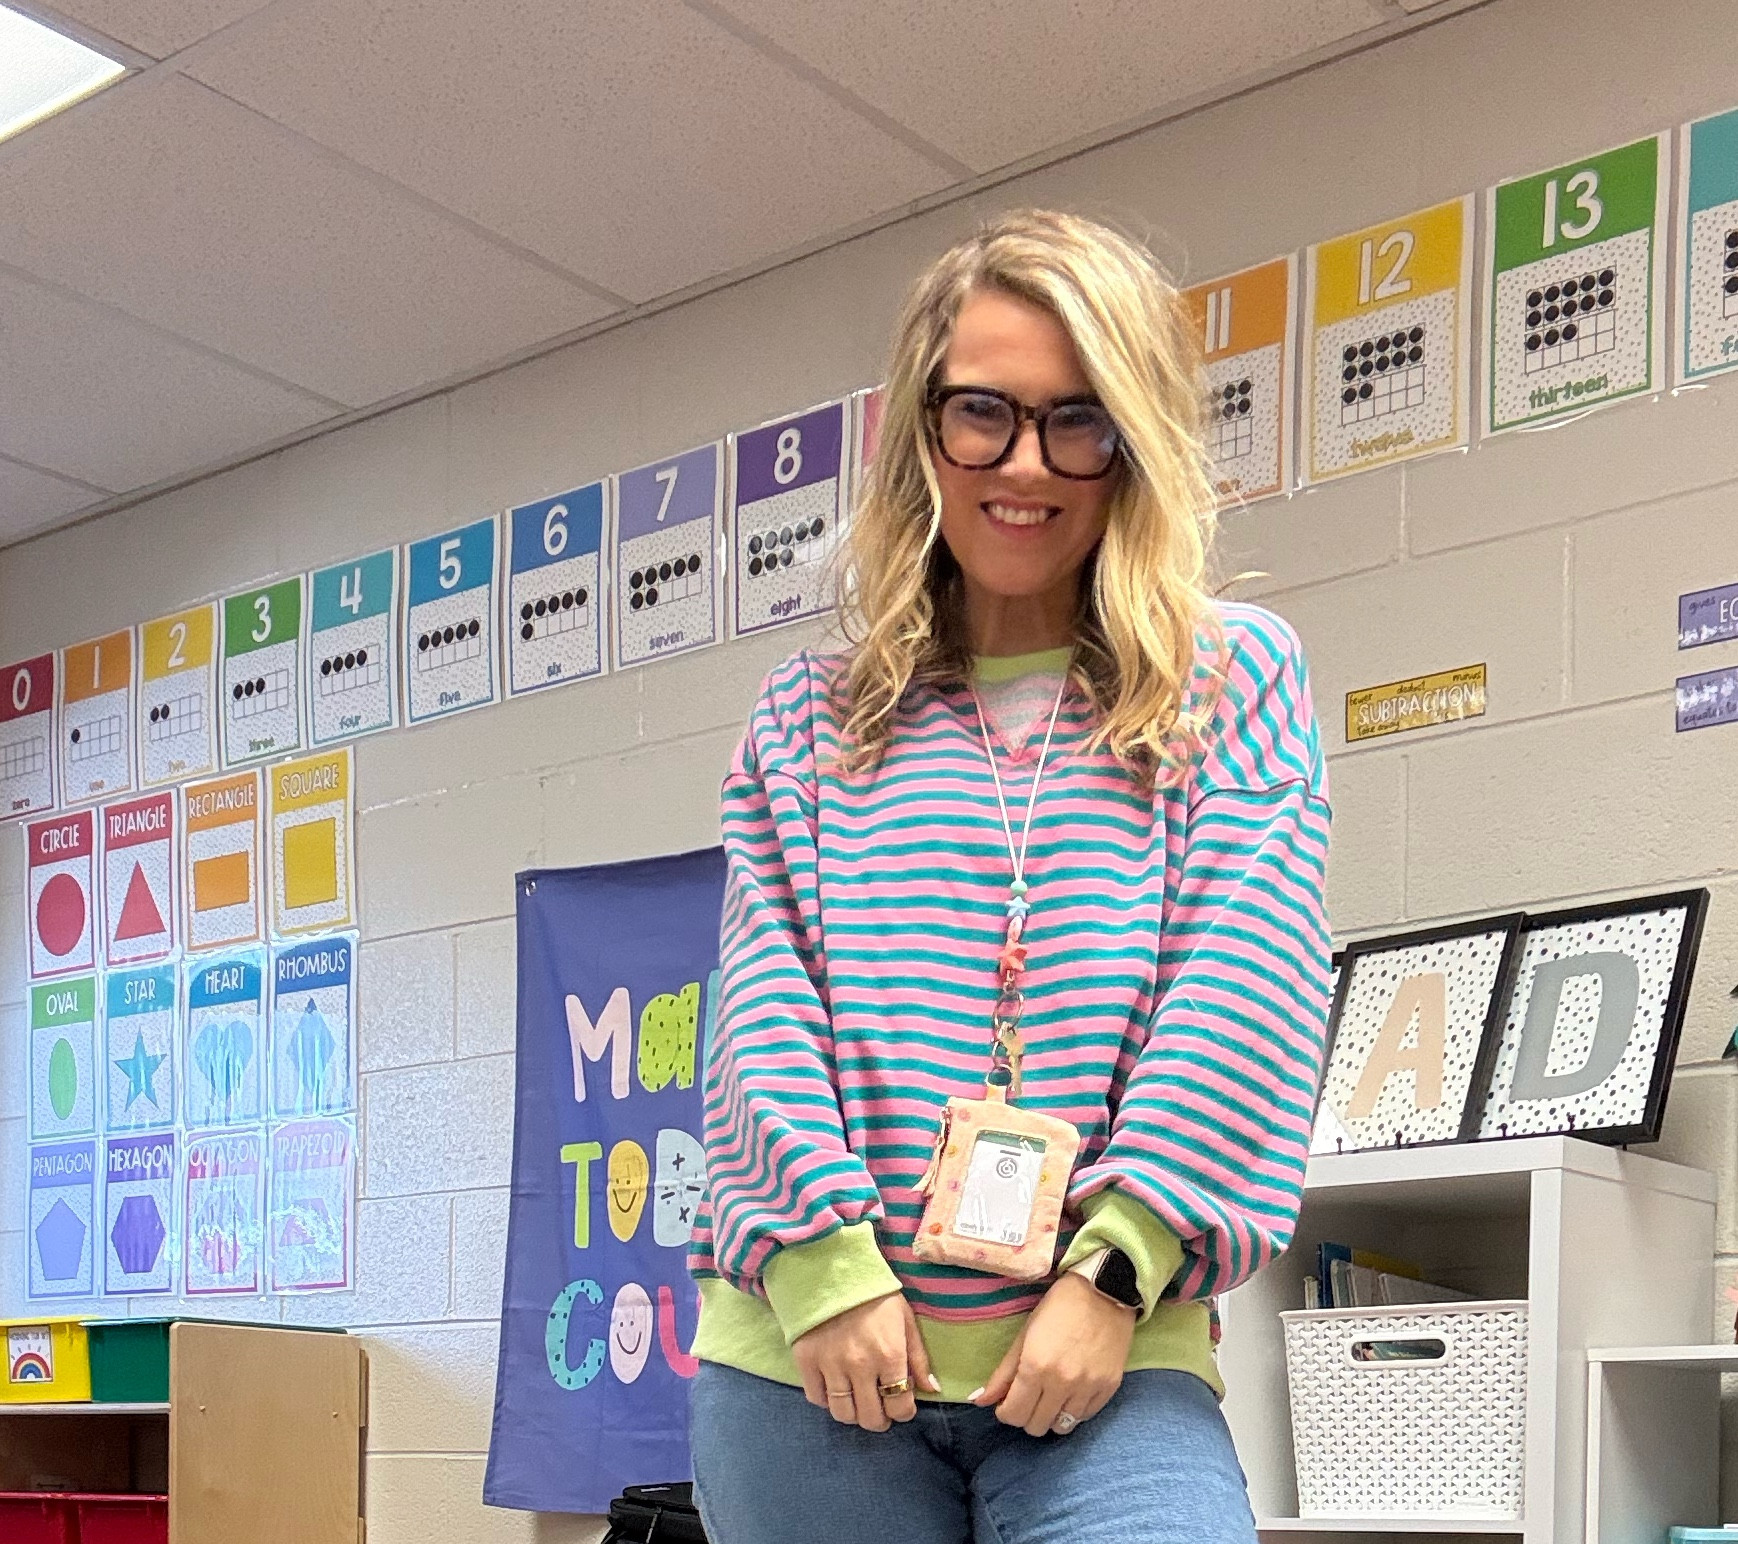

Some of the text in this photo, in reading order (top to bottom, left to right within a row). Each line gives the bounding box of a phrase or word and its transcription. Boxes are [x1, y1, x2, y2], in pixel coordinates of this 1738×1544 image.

[1542, 170, 1605, 249] 13
[1357, 231, 1416, 307] 12
[1203, 286, 1232, 354] 11
[1528, 373, 1609, 409] thirteen
[772, 427, 804, 486] 8
[655, 465, 679, 523] 7
[543, 504, 569, 557] 6
[439, 537, 463, 590] 5
[338, 567, 363, 615] 4
[770, 594, 802, 617] eight
[251, 595, 273, 643] 3
[167, 622, 187, 670] 2
[649, 630, 684, 650] seven
[92, 645, 101, 690] 1
[546, 661, 562, 678] six
[11, 669, 32, 712] 0
[439, 690, 462, 707] five
[1357, 682, 1479, 726] SUBTRACTION
[339, 715, 361, 730] four
[279, 763, 341, 801] SQUARE
[187, 783, 256, 820] RECTANGLE
[39, 823, 81, 854] CIRCLE
[108, 804, 167, 839] TRIANGLE
[204, 965, 246, 996] HEART
[277, 947, 349, 982] RHOMBUS
[45, 990, 80, 1016] OVAL
[123, 977, 157, 1005] STAR
[1344, 950, 1641, 1120] A D
[108, 1143, 174, 1172] HEXAGON
[189, 1138, 261, 1168] OCTAGON
[276, 1129, 347, 1157] TRAPEZOID
[32, 1152, 94, 1178] PENTAGON
